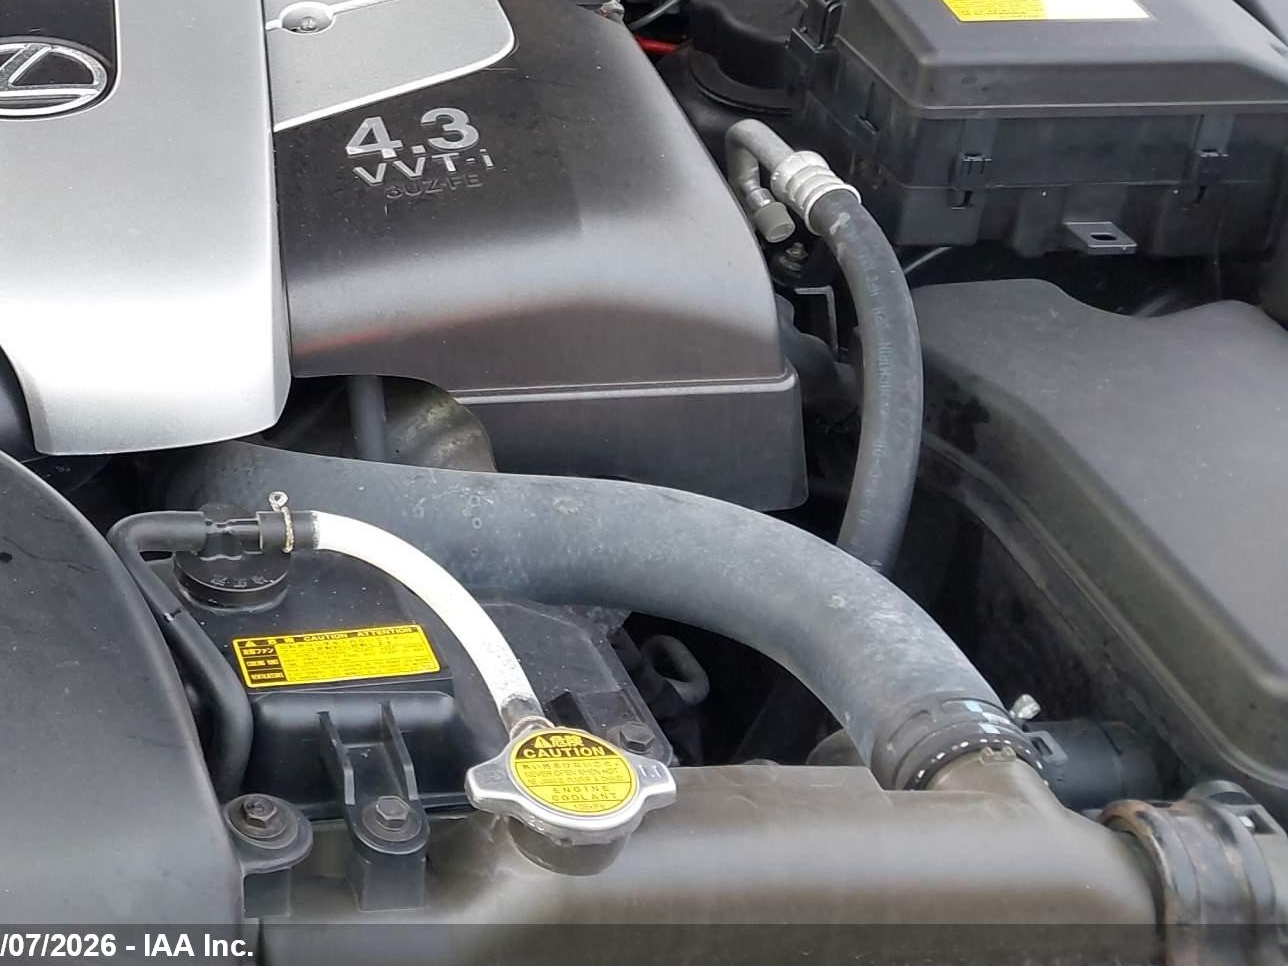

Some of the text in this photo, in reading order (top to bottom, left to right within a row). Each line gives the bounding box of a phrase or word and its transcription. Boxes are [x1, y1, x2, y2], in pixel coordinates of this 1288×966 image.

[345, 107, 480, 160] 4.3
[352, 148, 495, 186] VVT-i
[385, 174, 483, 199] 3UZ-FE
[303, 633, 348, 642] CAUTION
[356, 627, 413, 638] ATTENTION
[523, 746, 606, 759] CAUTION
[551, 793, 618, 802] COOLANT
[552, 786, 610, 794] ENGINE
